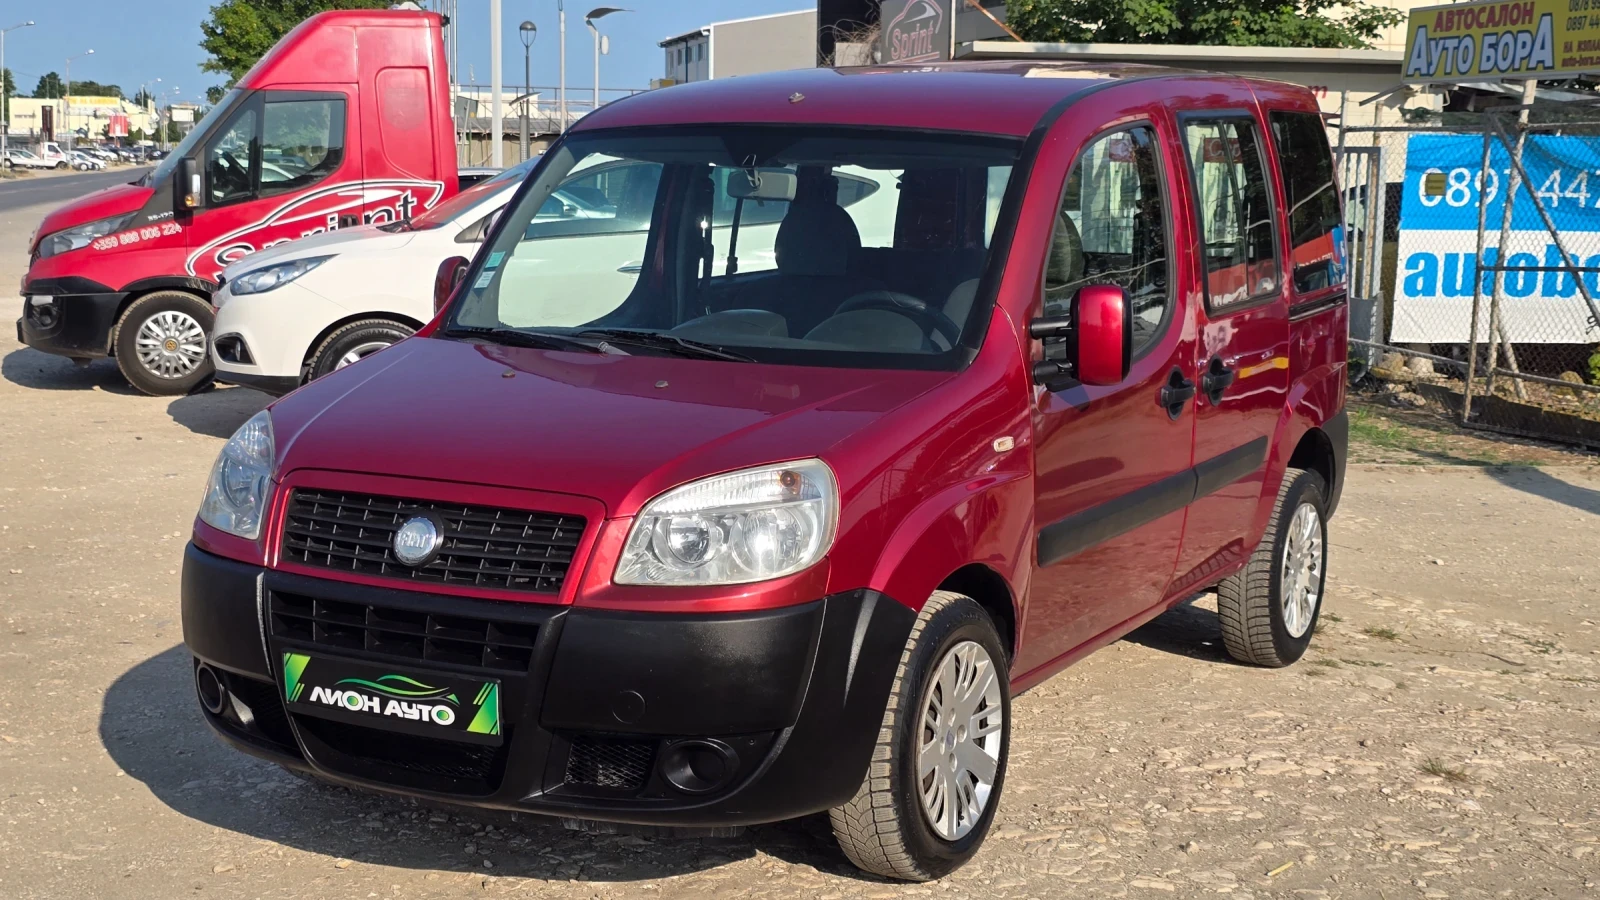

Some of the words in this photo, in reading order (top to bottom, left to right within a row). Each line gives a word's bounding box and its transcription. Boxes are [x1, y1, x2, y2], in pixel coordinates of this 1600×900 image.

[1433, 2, 1535, 33] АВТОСАЛОН
[1566, 15, 1587, 31] 0897
[891, 20, 934, 60] Sprint
[1405, 25, 1476, 77] АУТО
[1478, 13, 1554, 73] БОРА
[1538, 169, 1600, 208] 44
[213, 189, 417, 282] Sint
[401, 531, 431, 548] FIAT
[309, 686, 381, 713] ЛИОН
[384, 700, 456, 726] АУТО
